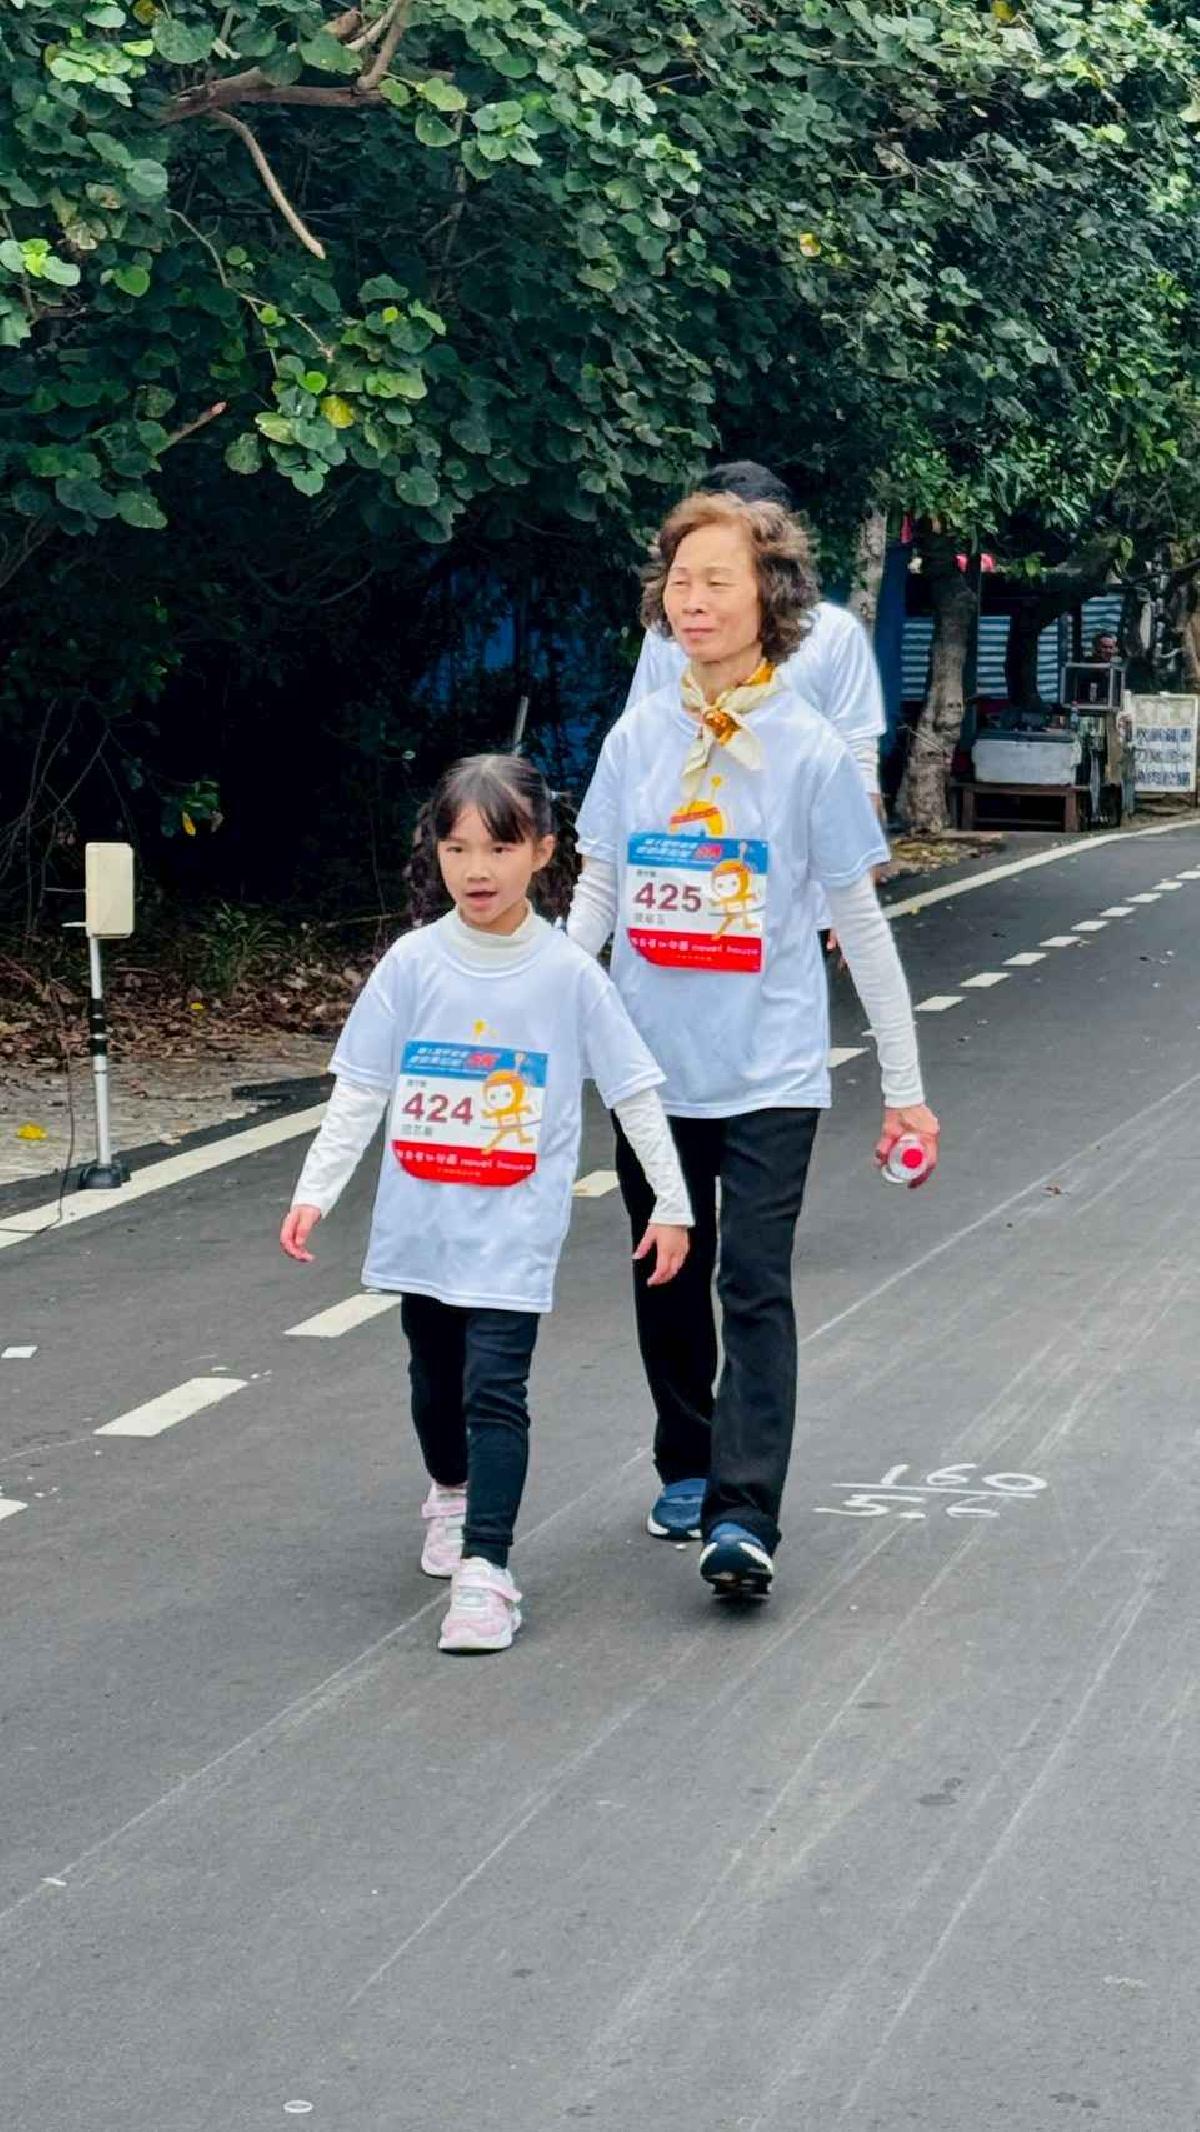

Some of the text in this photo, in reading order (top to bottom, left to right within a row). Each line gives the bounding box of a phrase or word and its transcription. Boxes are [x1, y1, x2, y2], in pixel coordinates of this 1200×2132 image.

[634, 882, 702, 912] 425
[403, 1092, 473, 1125] 424
[881, 1463, 1048, 1491] 160
